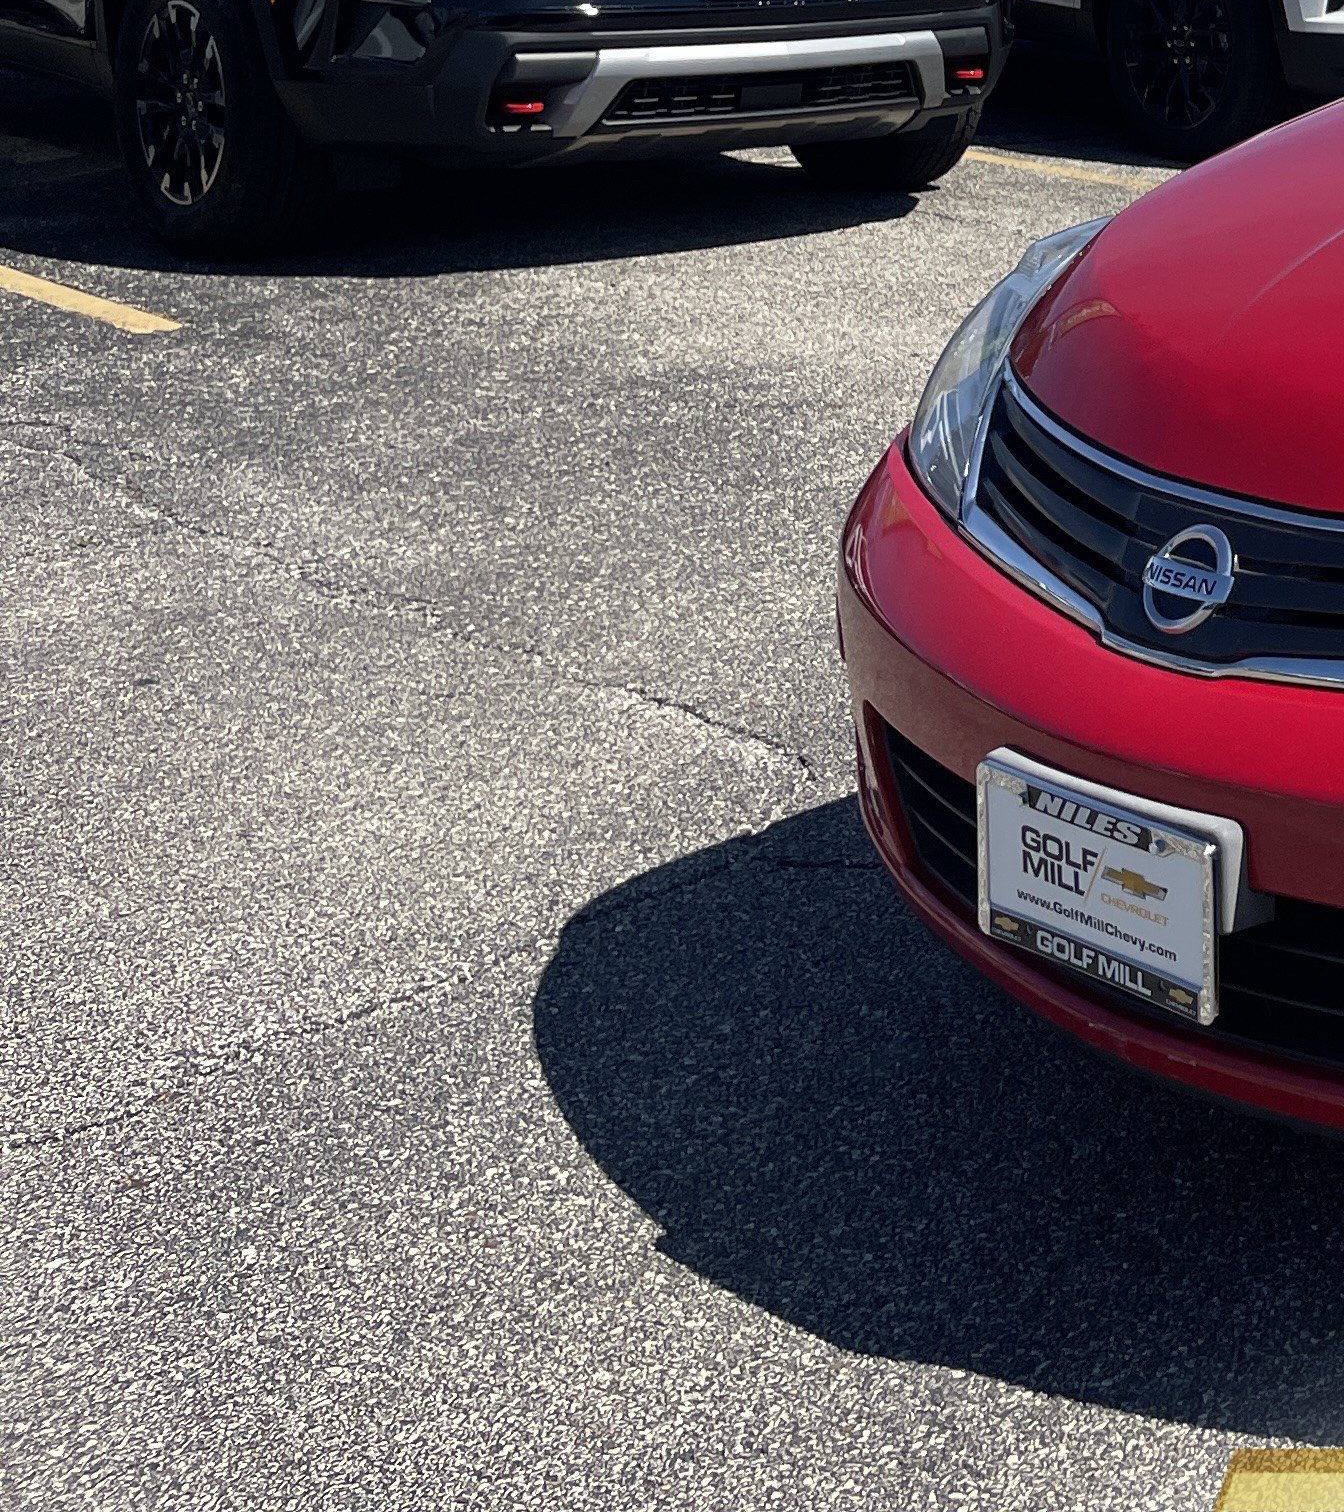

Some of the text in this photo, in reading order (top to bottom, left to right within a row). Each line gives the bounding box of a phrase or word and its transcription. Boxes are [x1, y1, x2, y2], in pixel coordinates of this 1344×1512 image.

[1148, 562, 1217, 595] NISSAN
[1035, 791, 1142, 845] NILES
[1021, 825, 1099, 873] GOLF
[1022, 849, 1086, 896] MILL
[1016, 889, 1177, 962] www.GolfMillChevy.com
[1101, 893, 1169, 927] CHEVROLET
[1036, 930, 1152, 996] GOLF MILL
